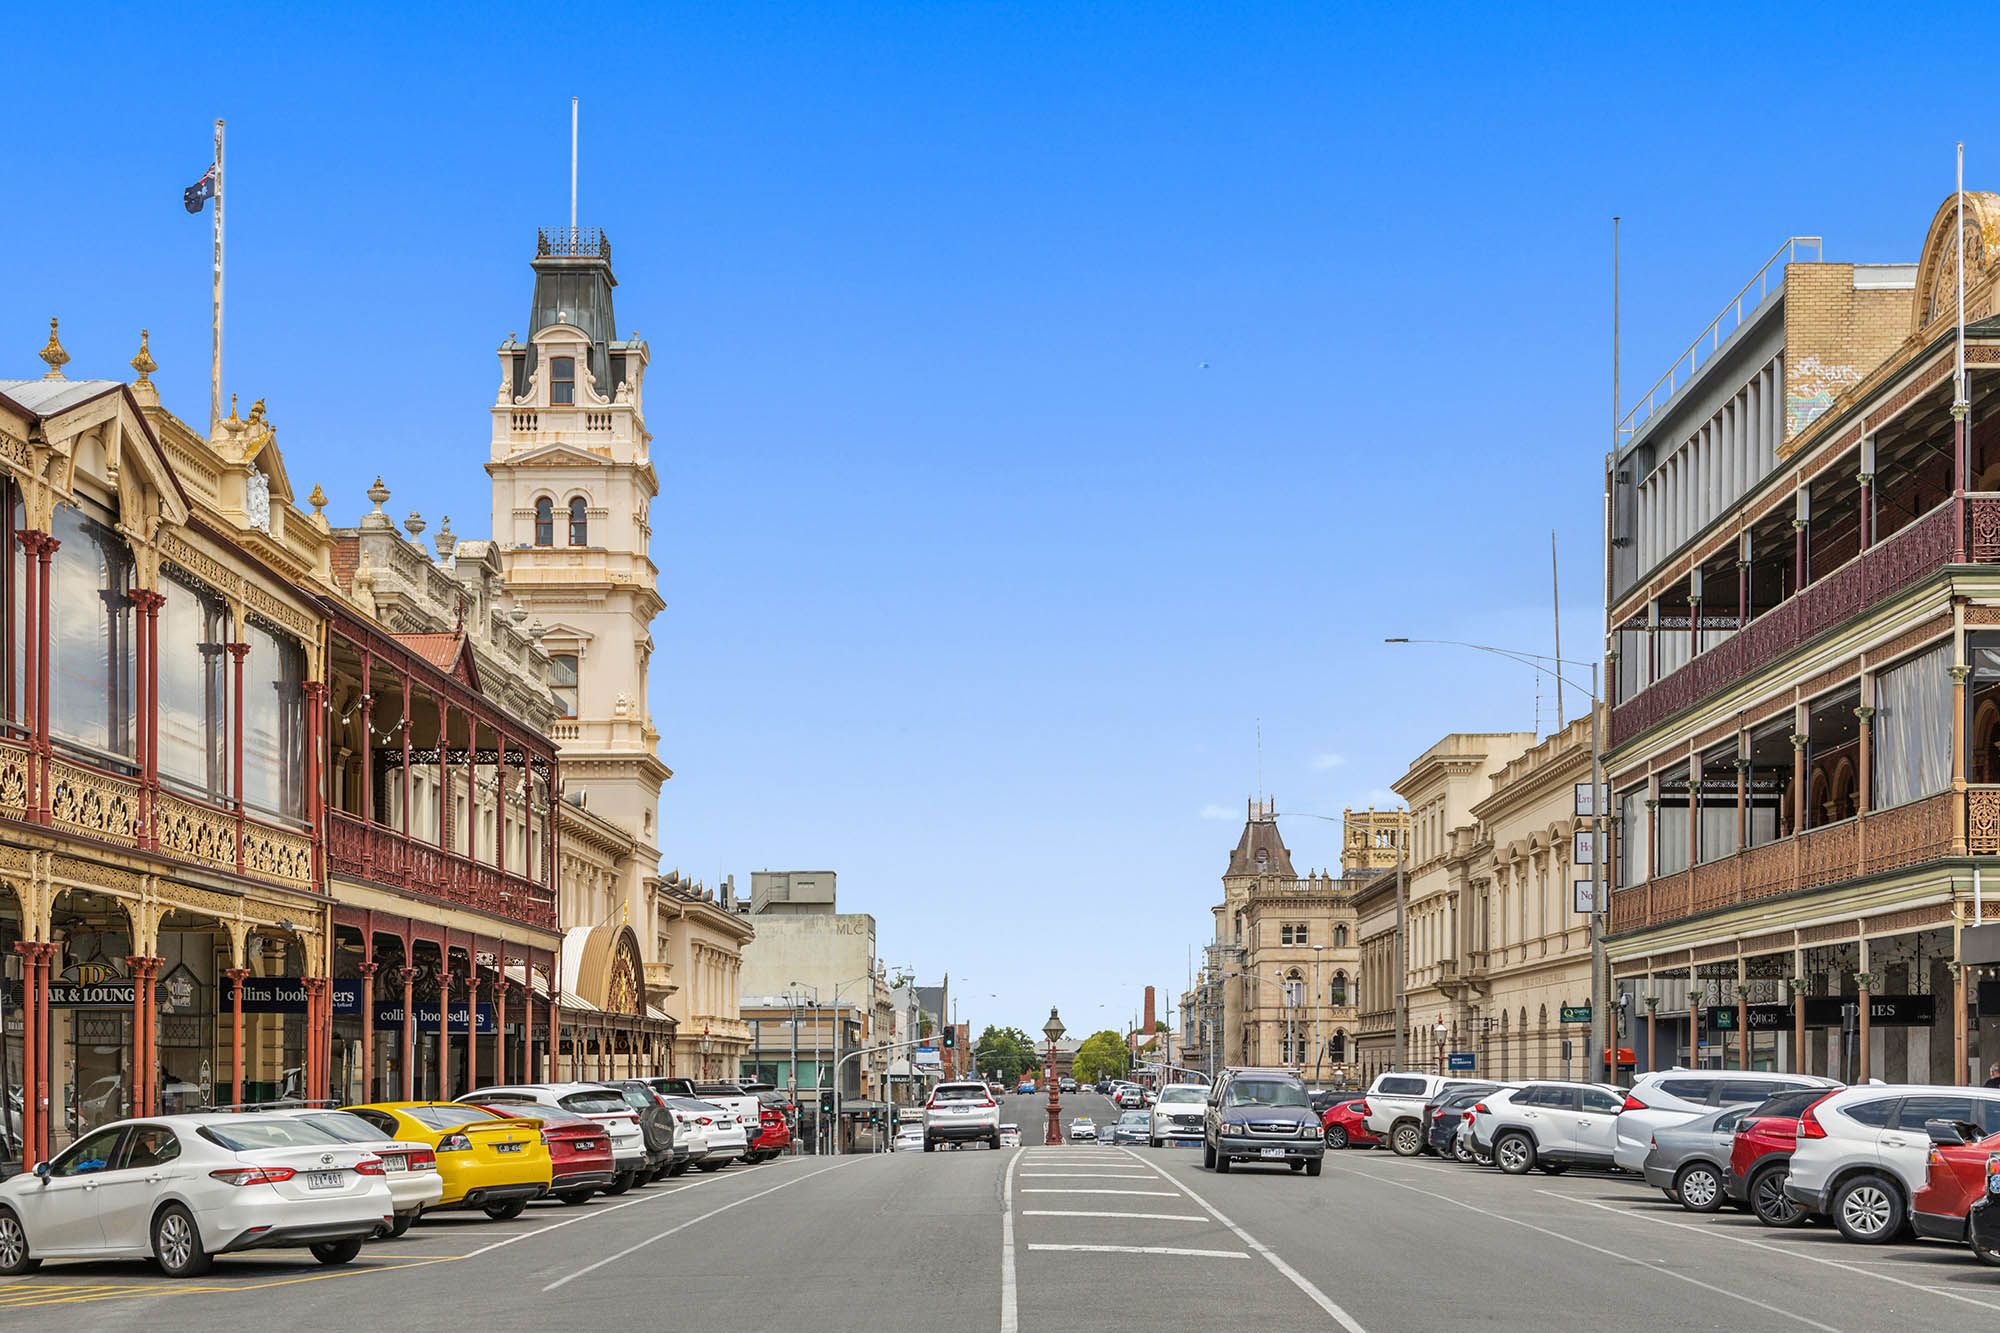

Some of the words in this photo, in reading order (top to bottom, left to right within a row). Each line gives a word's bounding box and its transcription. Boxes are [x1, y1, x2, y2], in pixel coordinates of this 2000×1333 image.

[837, 924, 864, 935] MLC
[69, 988, 79, 1001] &
[227, 987, 271, 1001] cllins
[420, 1009, 484, 1022] boosellers
